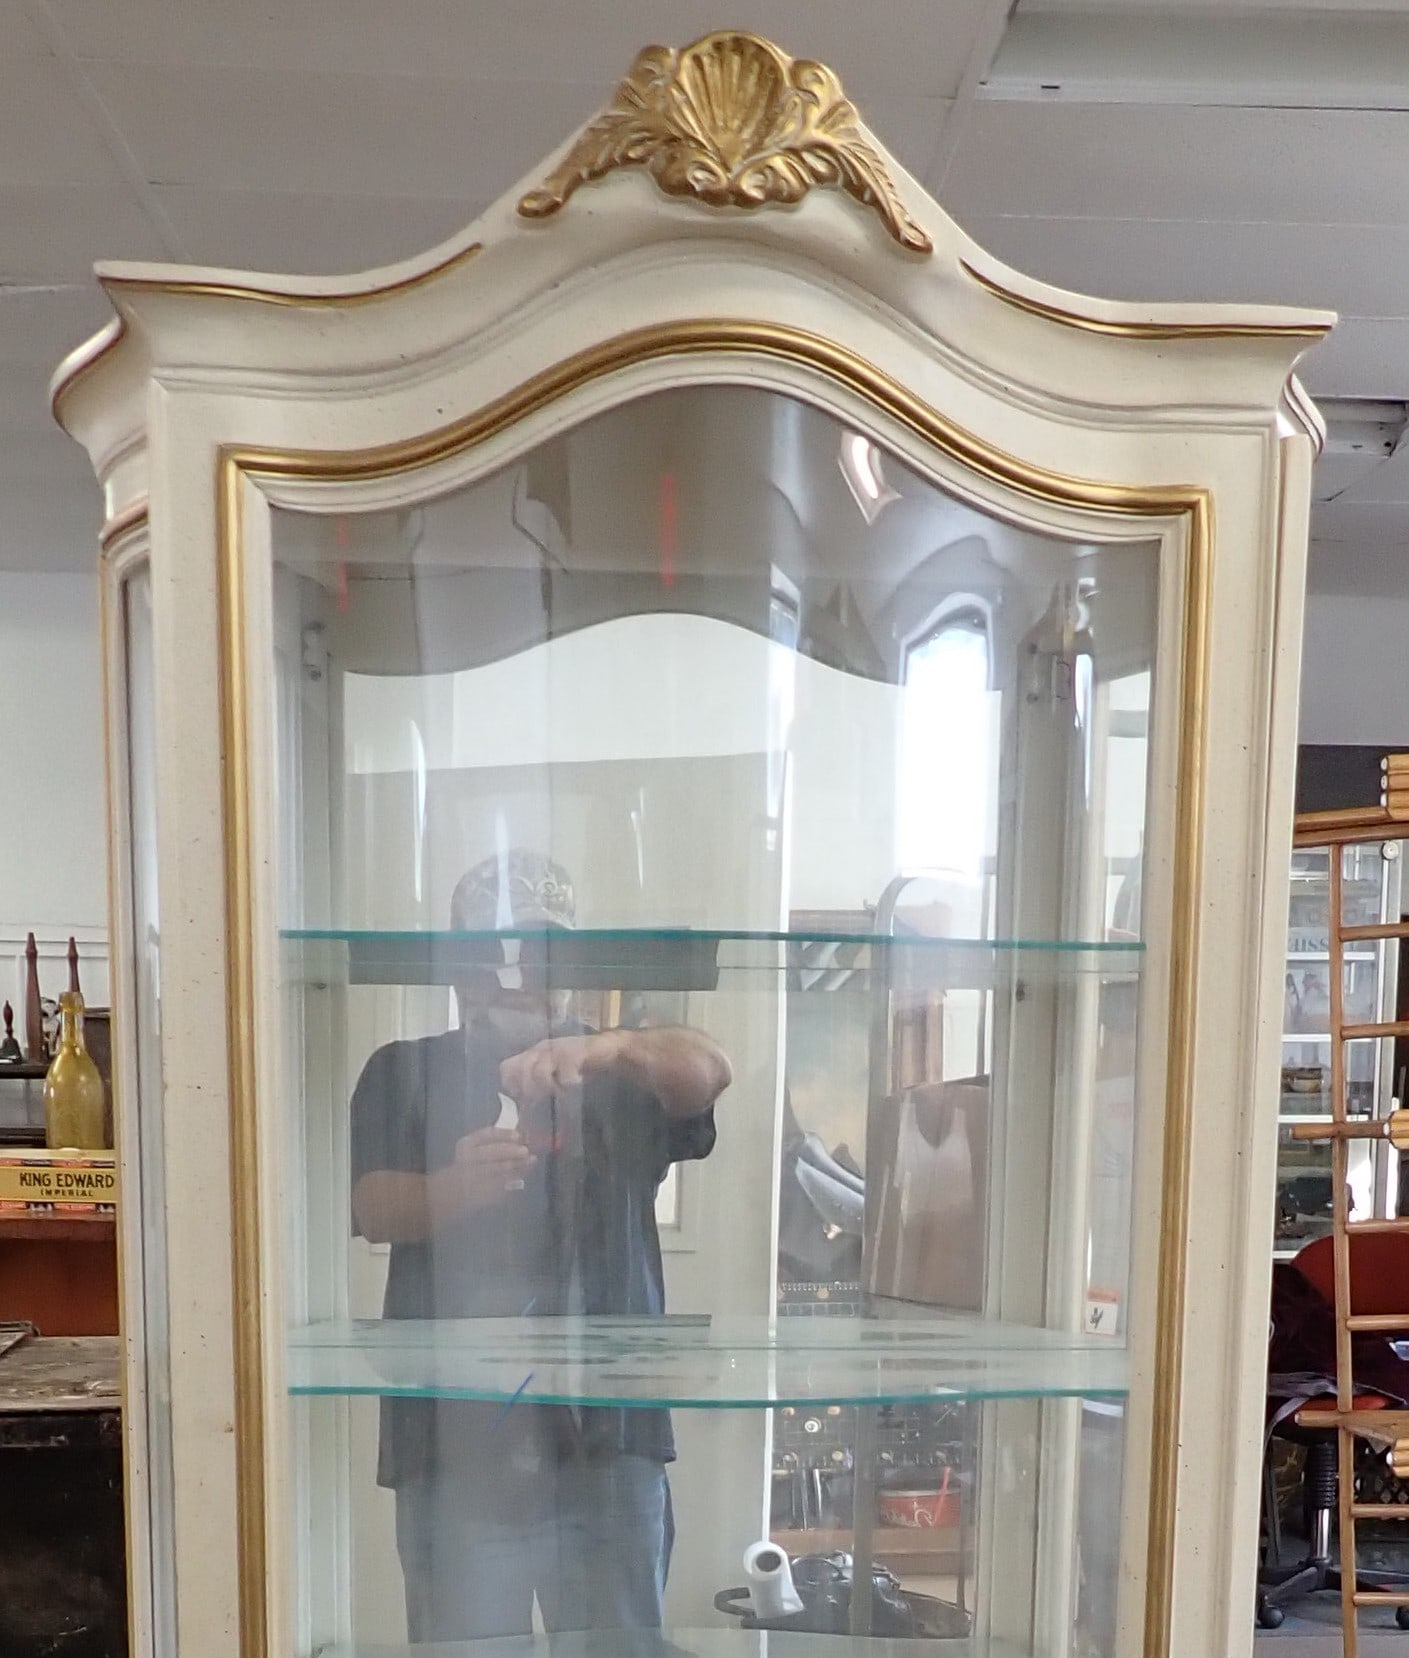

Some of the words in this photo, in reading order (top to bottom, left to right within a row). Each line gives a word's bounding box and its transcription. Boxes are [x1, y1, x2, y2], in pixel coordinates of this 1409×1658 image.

[20, 1172, 51, 1187] KING
[56, 1173, 115, 1188] EDWARD
[40, 1188, 94, 1197] IMPERIAL
